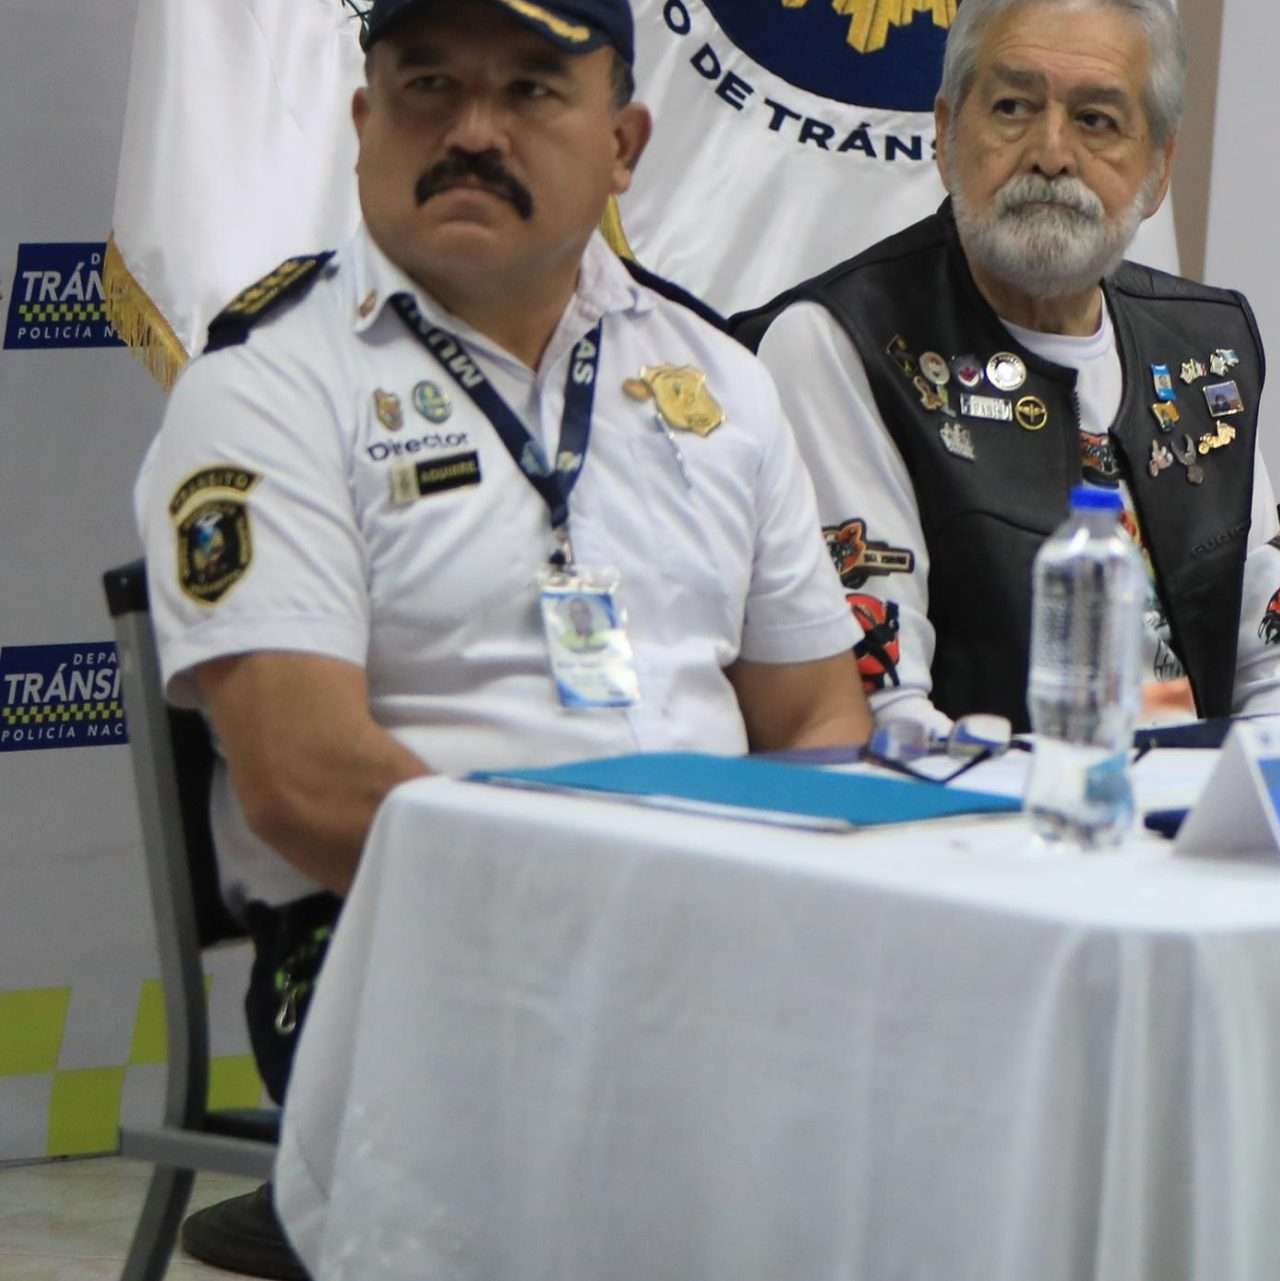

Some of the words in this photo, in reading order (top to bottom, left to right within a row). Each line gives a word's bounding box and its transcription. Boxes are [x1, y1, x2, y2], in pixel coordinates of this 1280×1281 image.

[690, 42, 754, 111] DE
[764, 97, 937, 162] TRÁN
[17, 324, 92, 339] POLICÍA
[4, 663, 121, 705] TRÁNSI
[1, 724, 76, 742] POLICÍA
